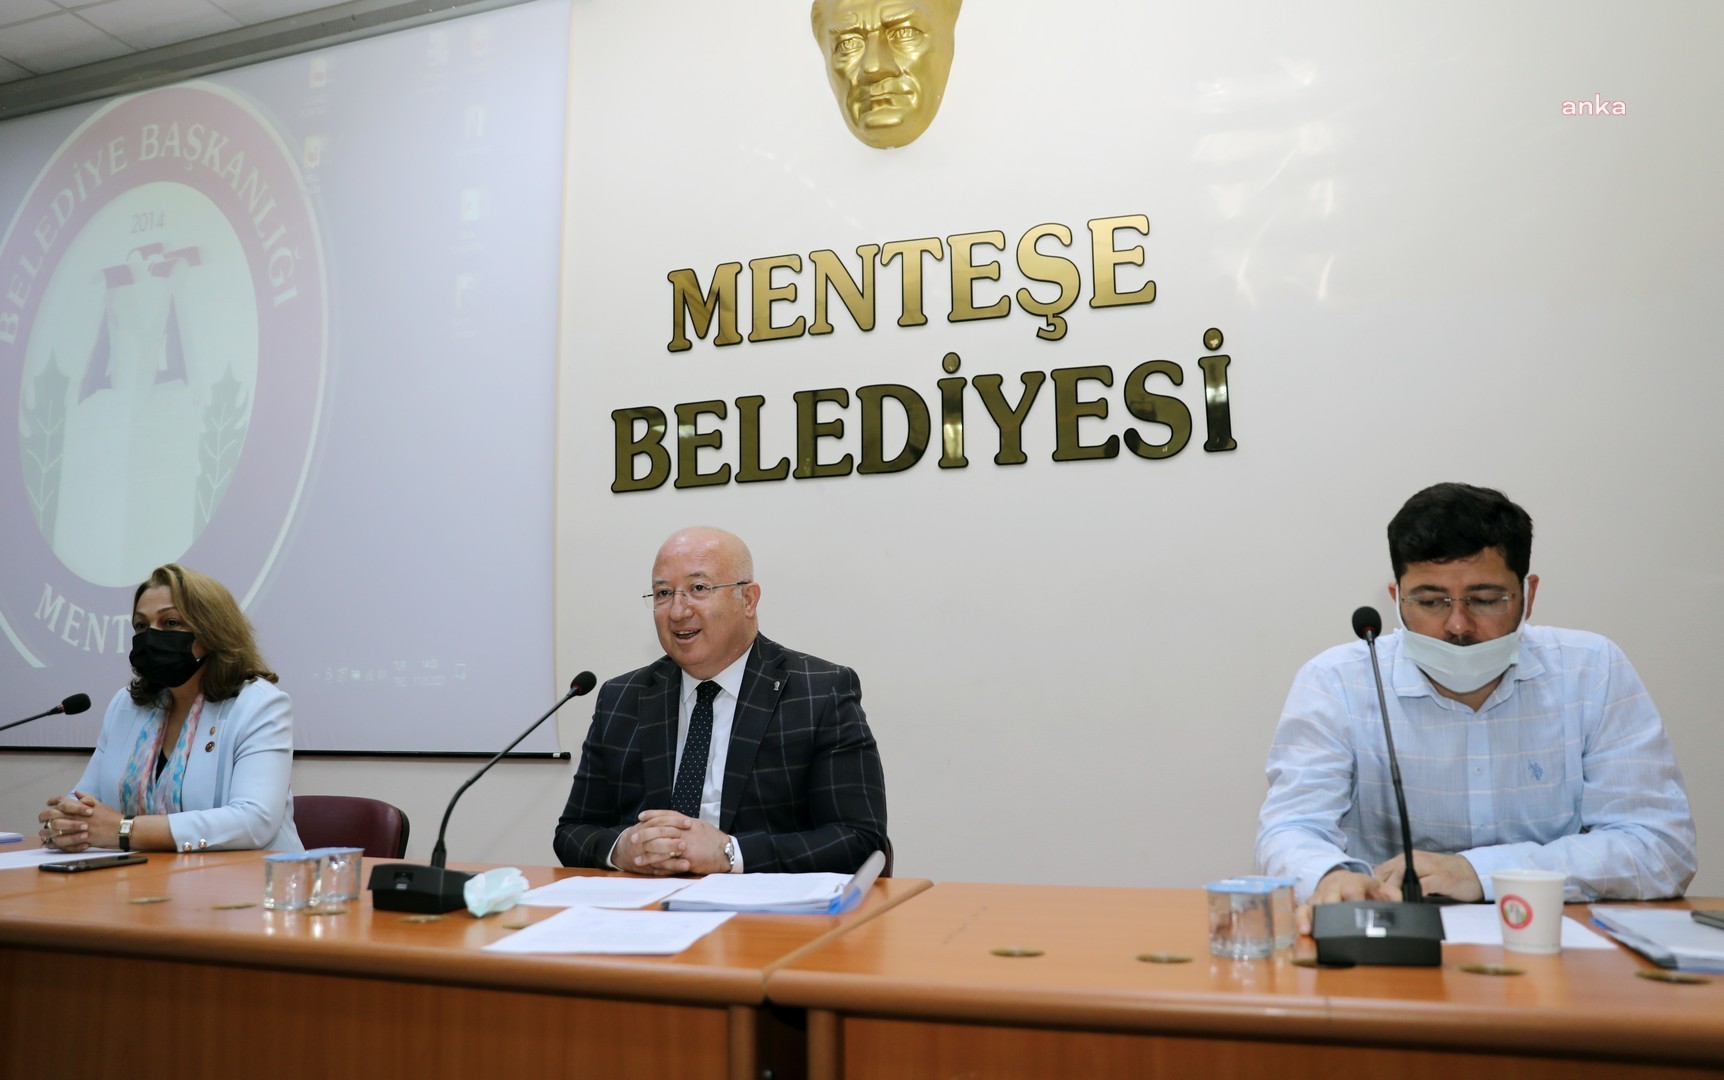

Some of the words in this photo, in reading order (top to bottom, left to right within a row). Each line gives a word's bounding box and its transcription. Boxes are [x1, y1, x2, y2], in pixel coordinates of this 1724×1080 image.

[0, 135, 127, 345] BELEDİYE
[138, 120, 303, 308] BAŞKANLIĞI
[131, 210, 166, 234] 2014
[666, 213, 1158, 352] MENTEŞE
[610, 327, 1238, 494] BELEDİYESİ
[33, 581, 132, 655] MENT
